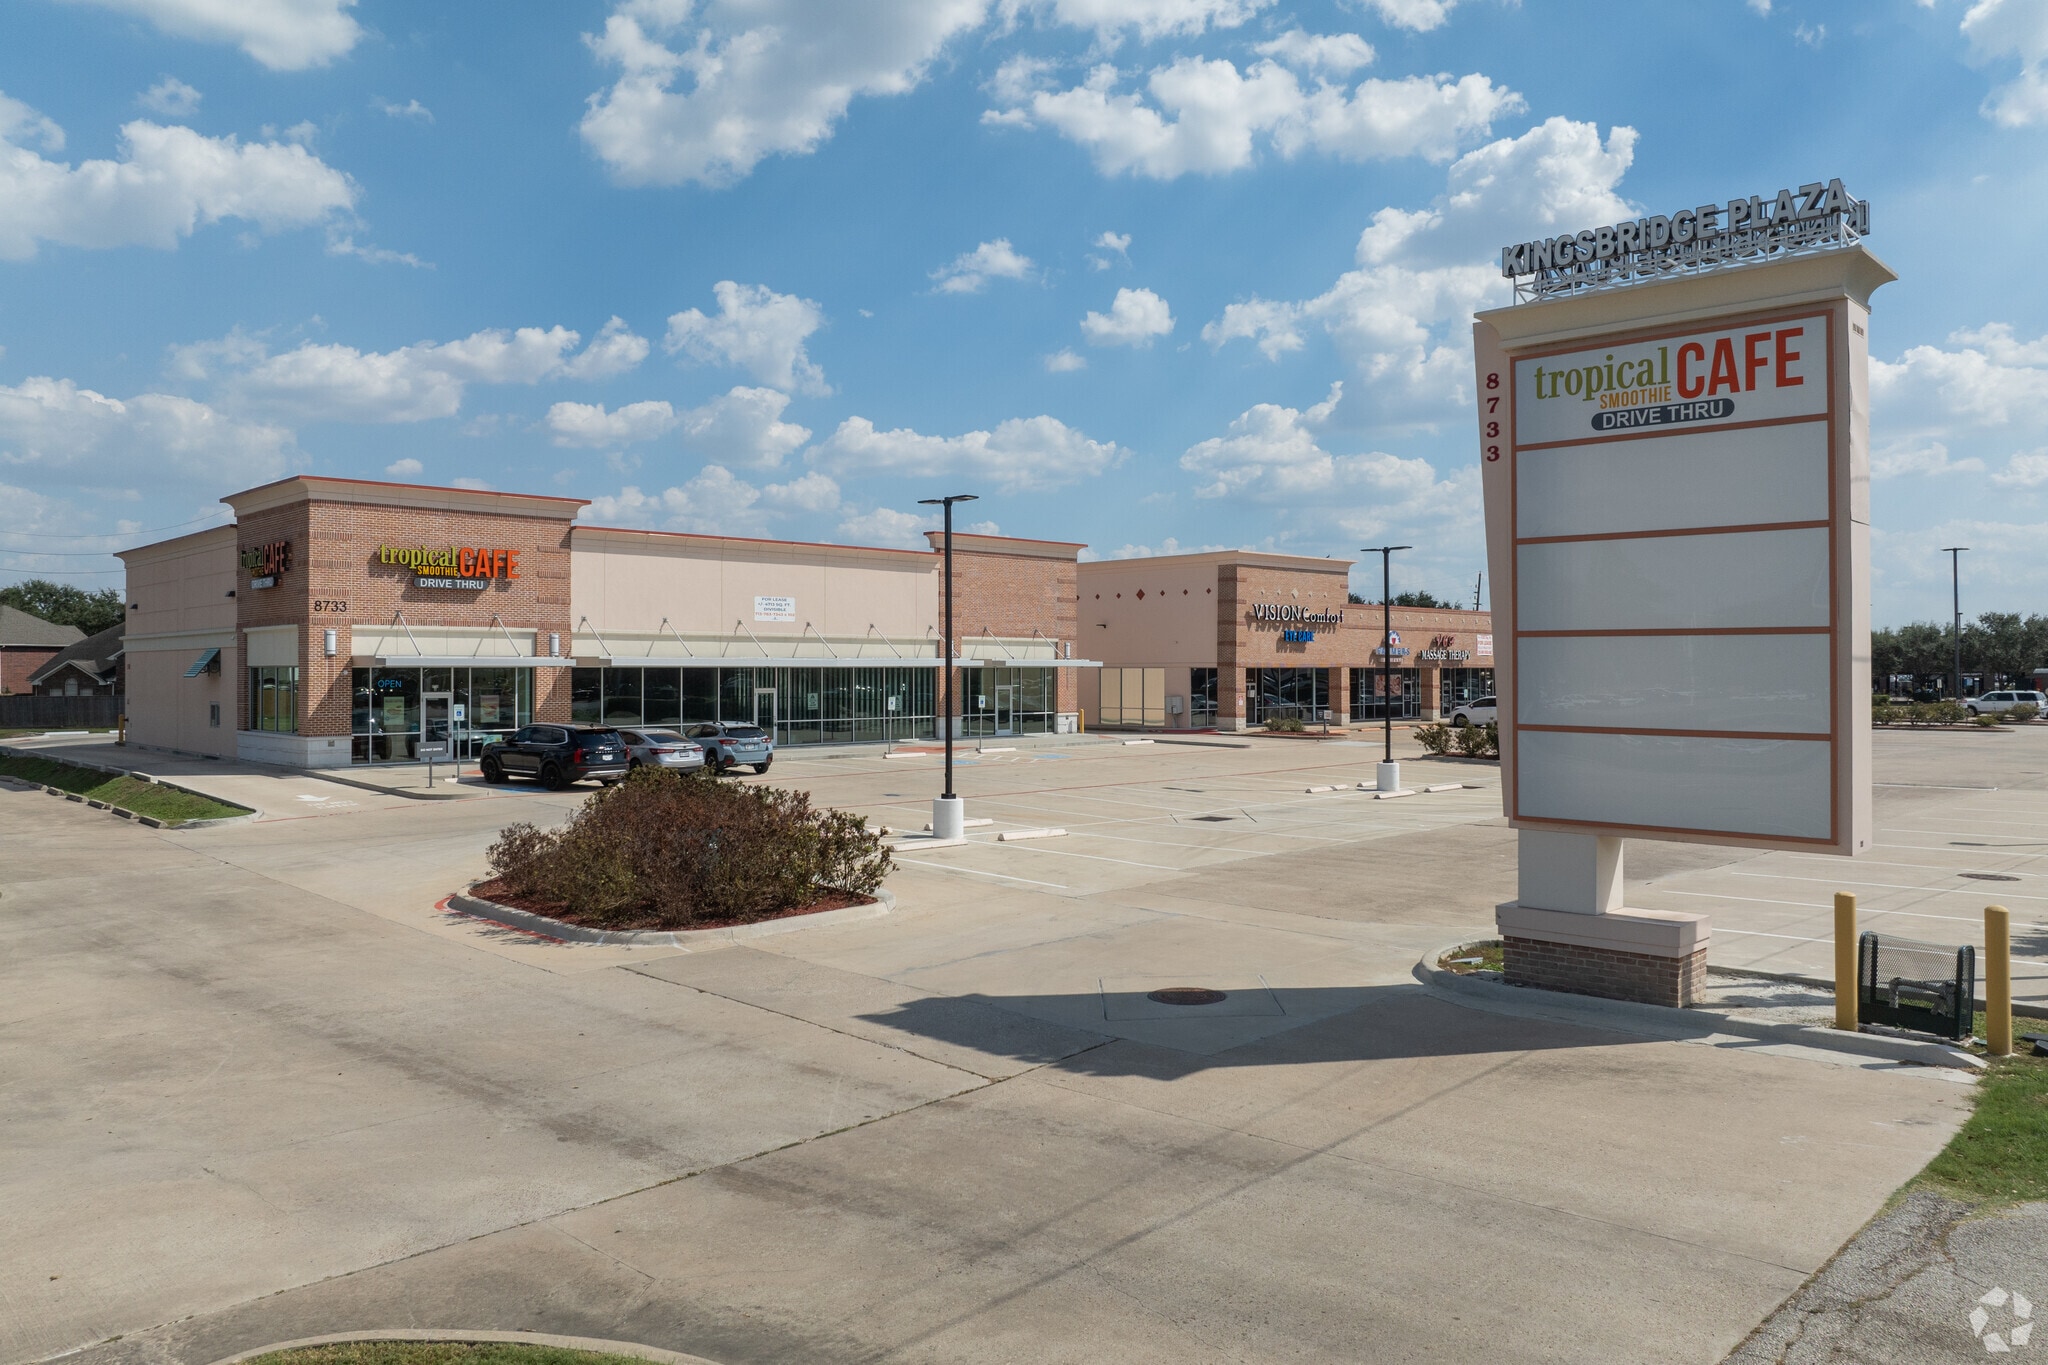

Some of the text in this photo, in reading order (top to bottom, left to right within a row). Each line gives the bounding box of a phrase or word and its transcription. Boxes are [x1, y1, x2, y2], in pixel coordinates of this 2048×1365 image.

[1502, 203, 1717, 278] KINGSBRIDGE
[1728, 178, 1850, 234] PLAZA
[1534, 327, 1804, 402] tropical CAFE
[1600, 386, 1672, 410] SMOOTHIE
[1486, 373, 1500, 462] 8733
[1602, 400, 1725, 429] DRIVE THRU
[263, 541, 286, 575] CAFE
[380, 544, 520, 579] tropical CAFE
[417, 565, 458, 577] SMOOTHIE
[420, 578, 484, 590] DRIVE THRU
[314, 600, 347, 612] 8733
[1253, 604, 1345, 623] VISION Comfort
[1284, 630, 1315, 642] EYE CARE
[1375, 647, 1410, 656] FAMERS
[1421, 650, 1470, 660] MASSAGE THERAPY
[378, 680, 402, 688] OPEN
